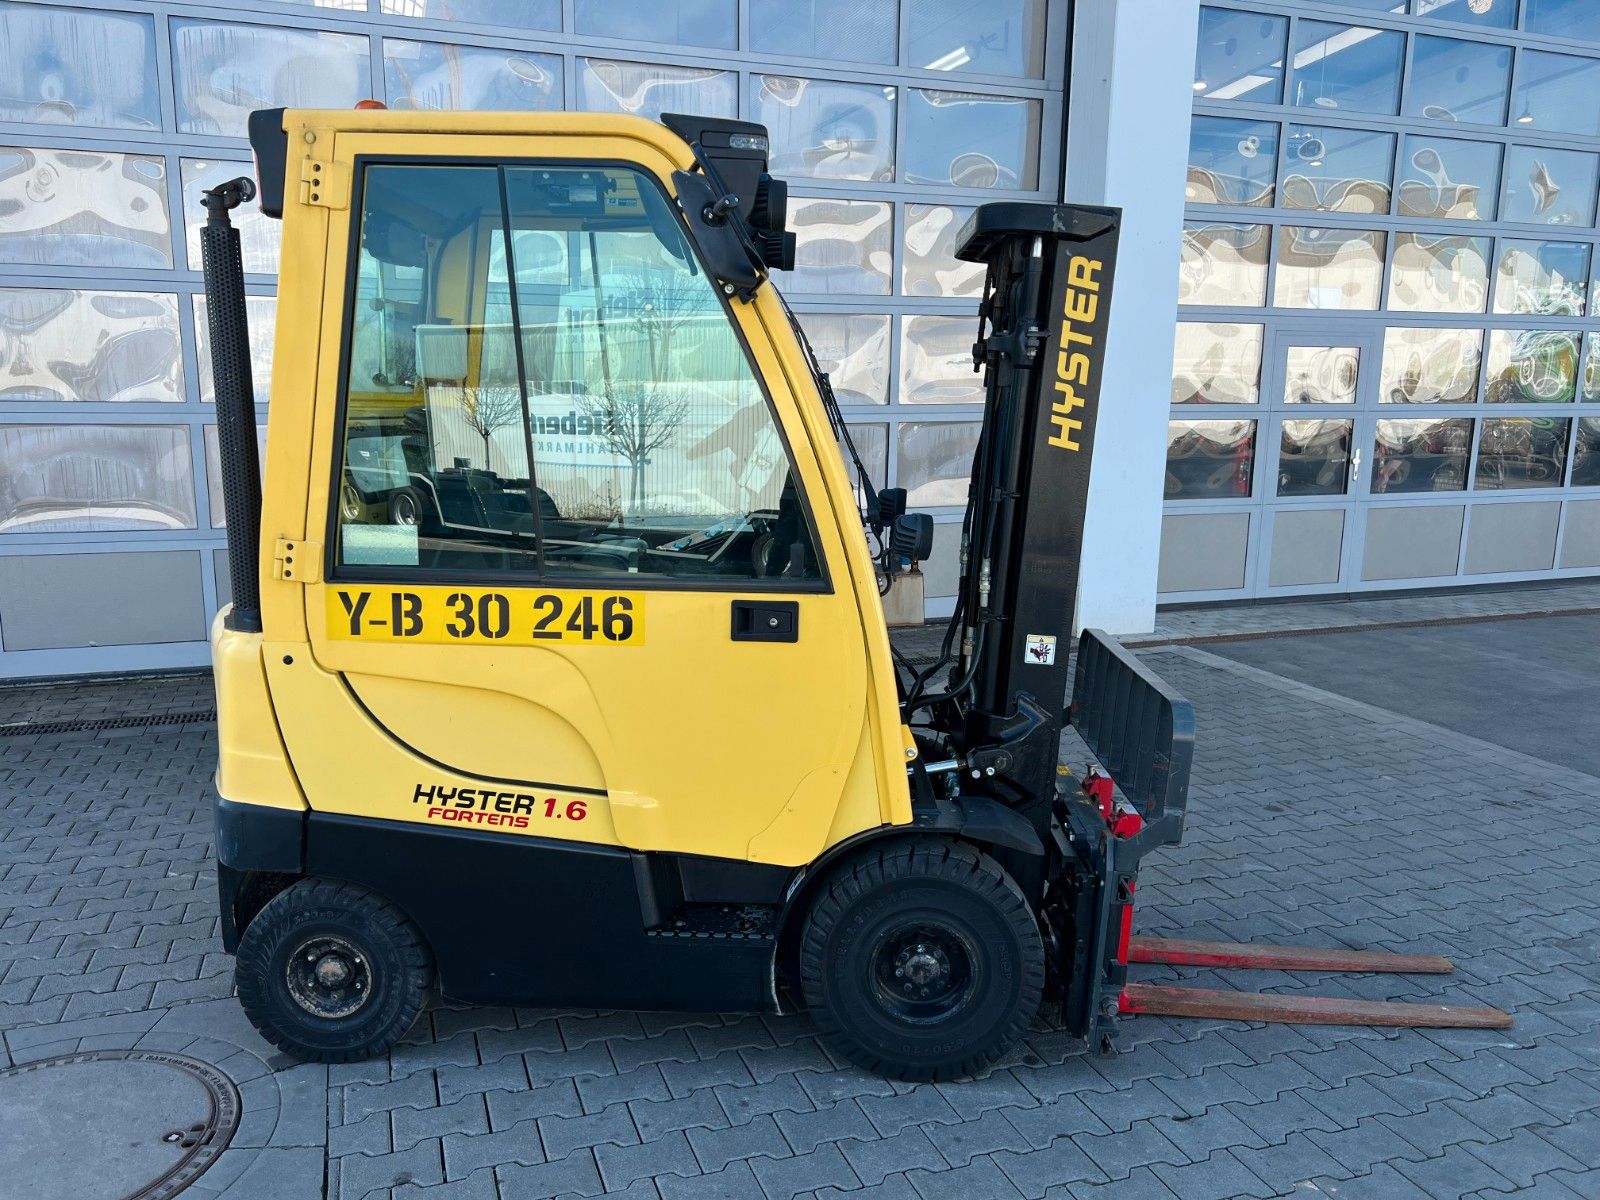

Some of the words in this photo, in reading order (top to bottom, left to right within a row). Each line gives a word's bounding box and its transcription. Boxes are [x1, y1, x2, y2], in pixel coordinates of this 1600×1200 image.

[1048, 255, 1103, 452] HYSTER
[337, 591, 424, 637] Y-B
[446, 593, 510, 639] 30
[533, 595, 634, 641] 246
[413, 784, 536, 815] HYSTER
[543, 798, 588, 821] 1.6
[428, 807, 530, 828] FORTENS
